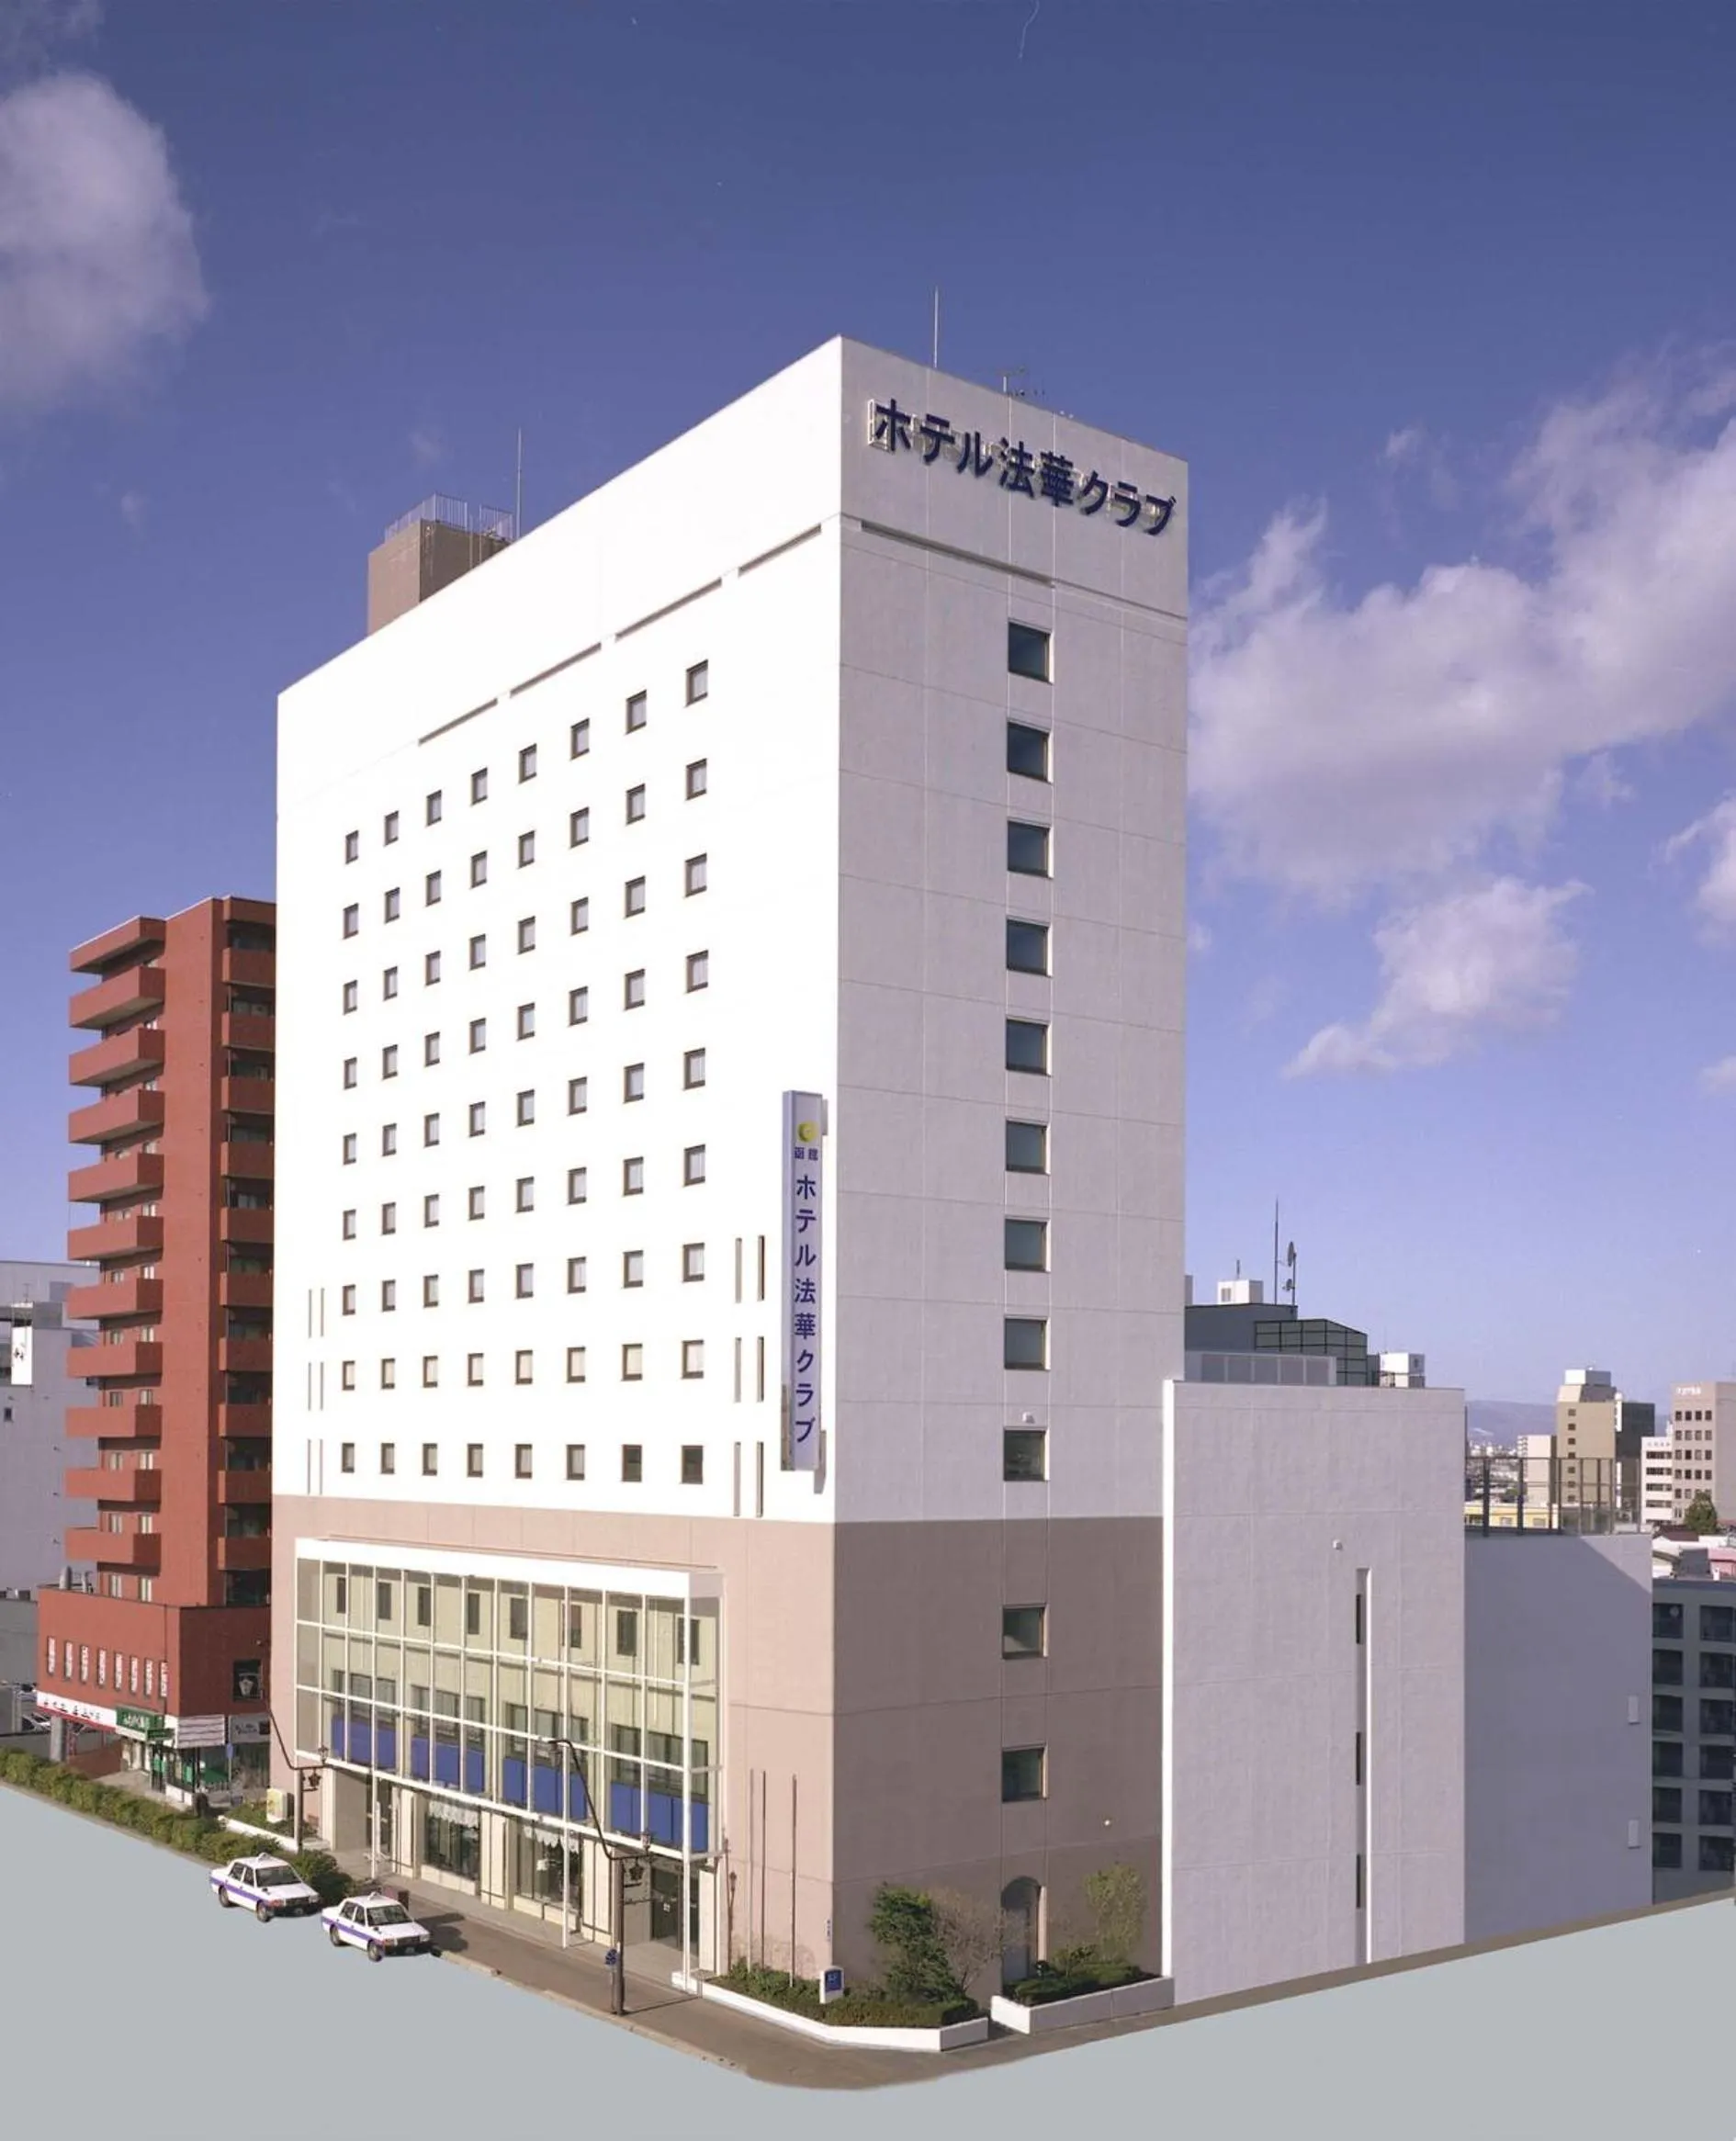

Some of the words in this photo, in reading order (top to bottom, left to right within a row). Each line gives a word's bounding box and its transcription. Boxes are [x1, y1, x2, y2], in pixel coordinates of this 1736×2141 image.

[874, 399, 1178, 536] ホテル法華クラブ
[794, 1175, 817, 1443] ホテル法華クラブ
